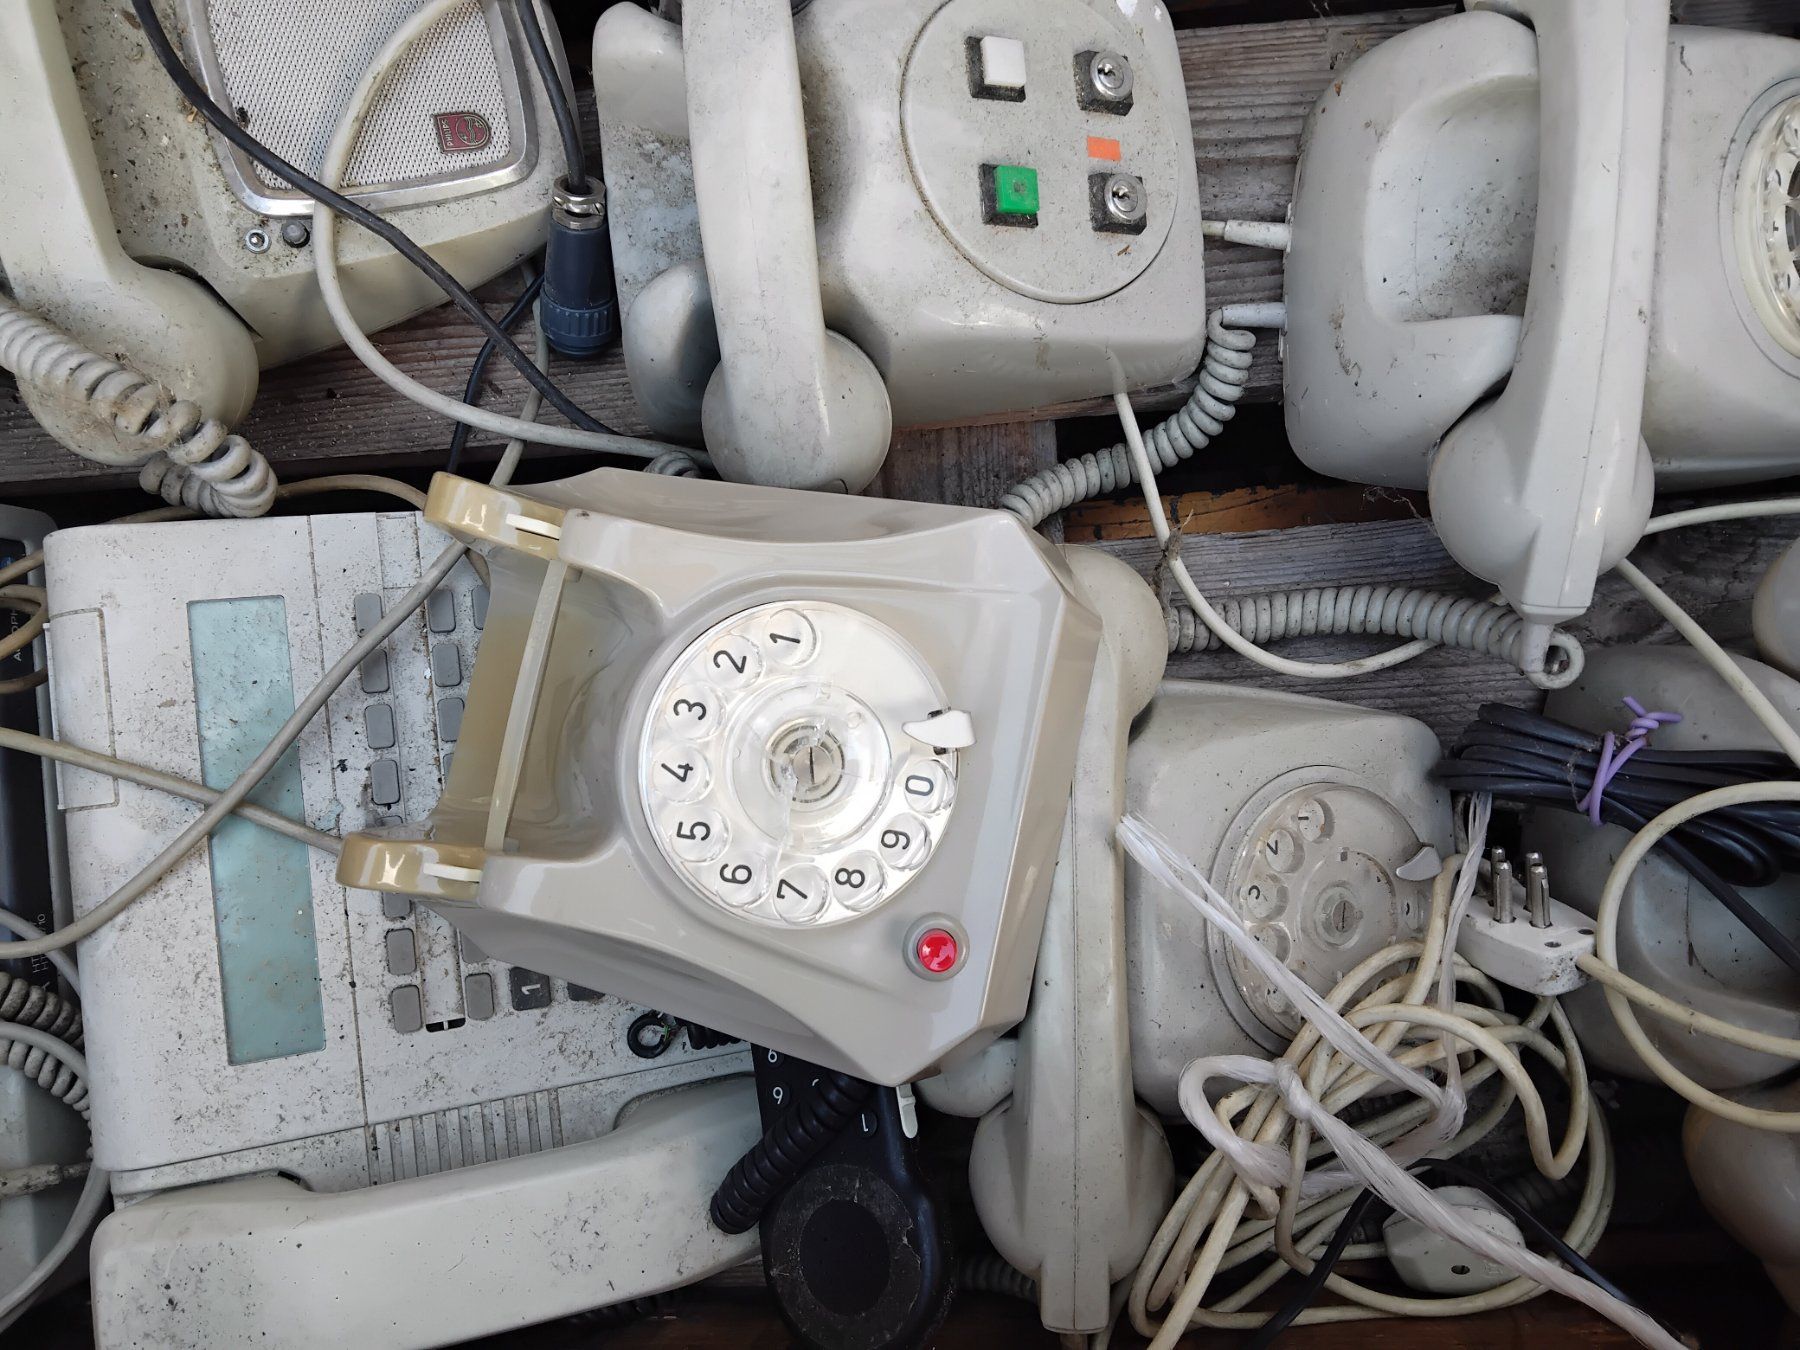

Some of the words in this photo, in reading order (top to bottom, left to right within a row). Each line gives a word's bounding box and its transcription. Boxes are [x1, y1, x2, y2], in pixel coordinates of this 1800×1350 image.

[441, 118, 454, 147] PHILIPS
[769, 633, 801, 644] 1
[713, 650, 747, 674] 2
[673, 699, 707, 721] 3
[661, 763, 694, 783] 4
[905, 774, 934, 797] 0
[676, 821, 711, 841] 5
[880, 829, 911, 850] 9
[719, 863, 753, 885] 6
[834, 867, 866, 889] 8
[776, 878, 808, 900] 7
[522, 984, 541, 995] 1
